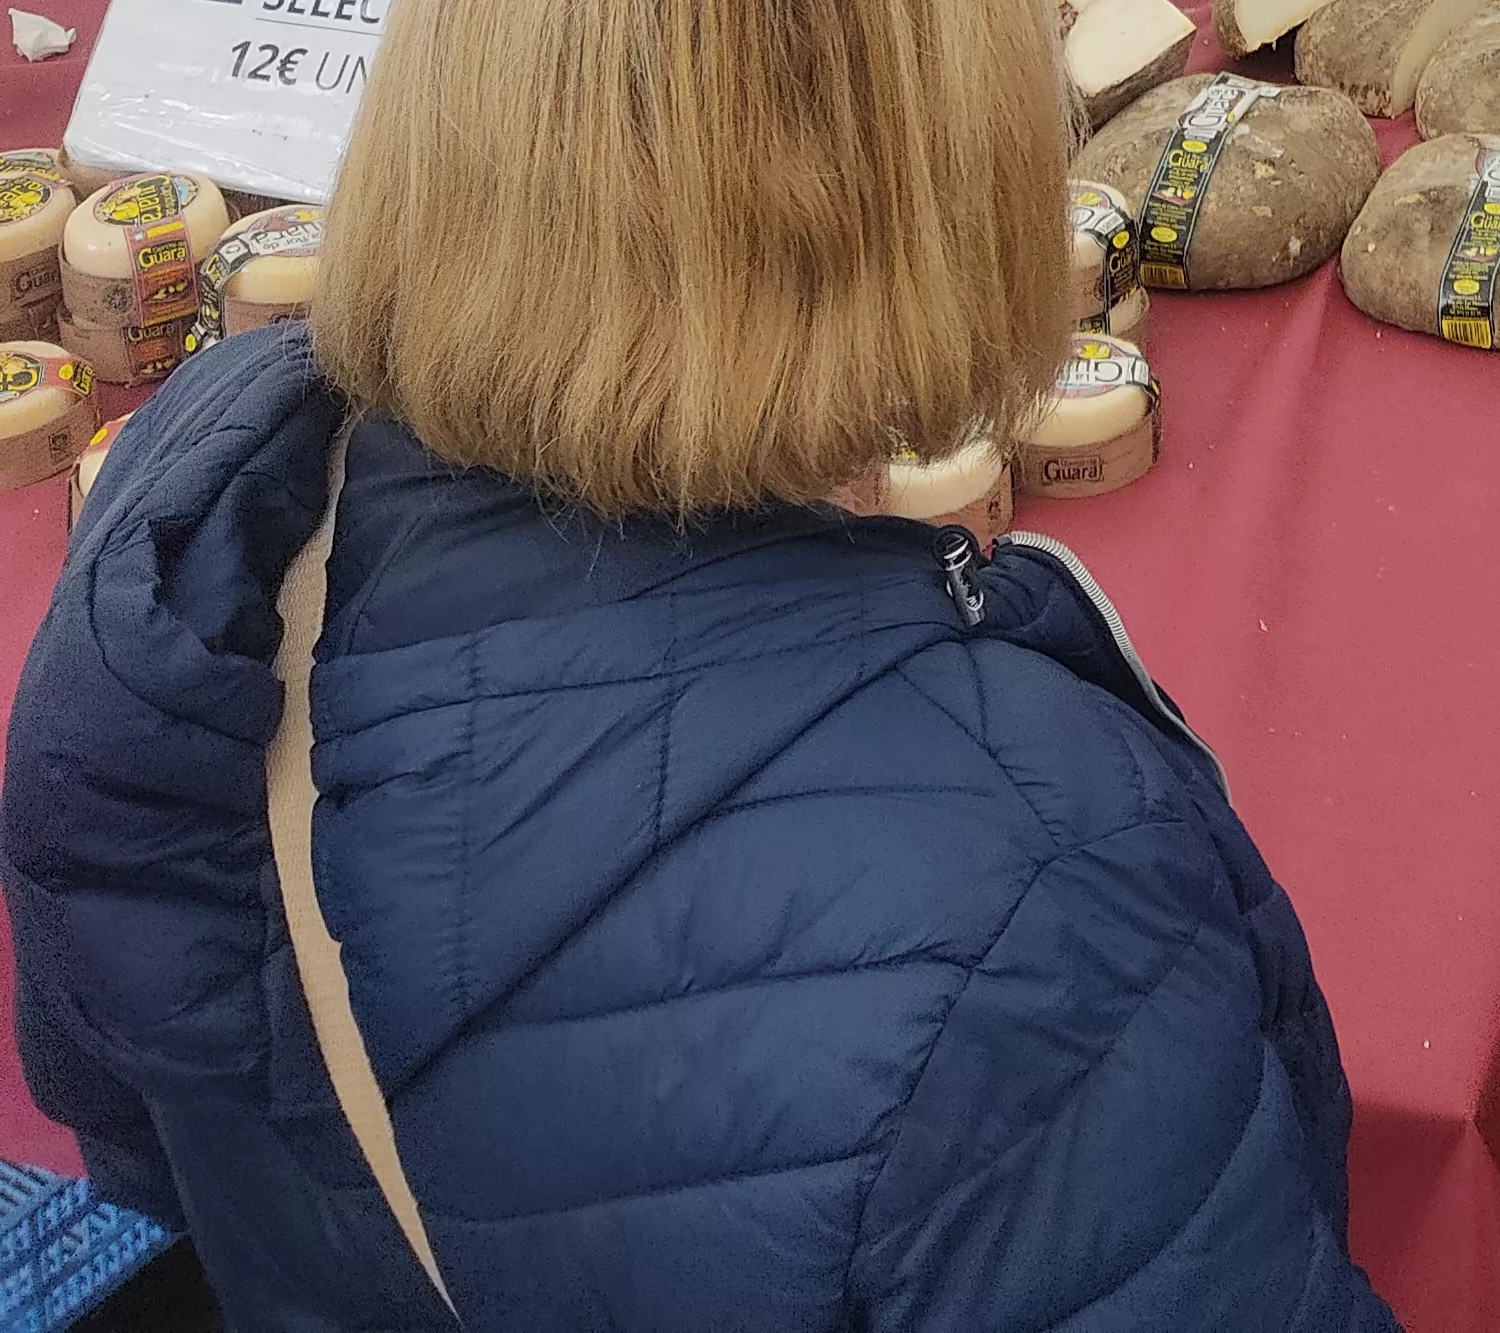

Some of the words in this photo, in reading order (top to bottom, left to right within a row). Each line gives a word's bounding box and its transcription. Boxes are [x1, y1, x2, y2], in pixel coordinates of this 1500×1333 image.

[231, 40, 308, 86] 12€
[138, 247, 187, 268] Guara
[1044, 459, 1098, 480] Guara
